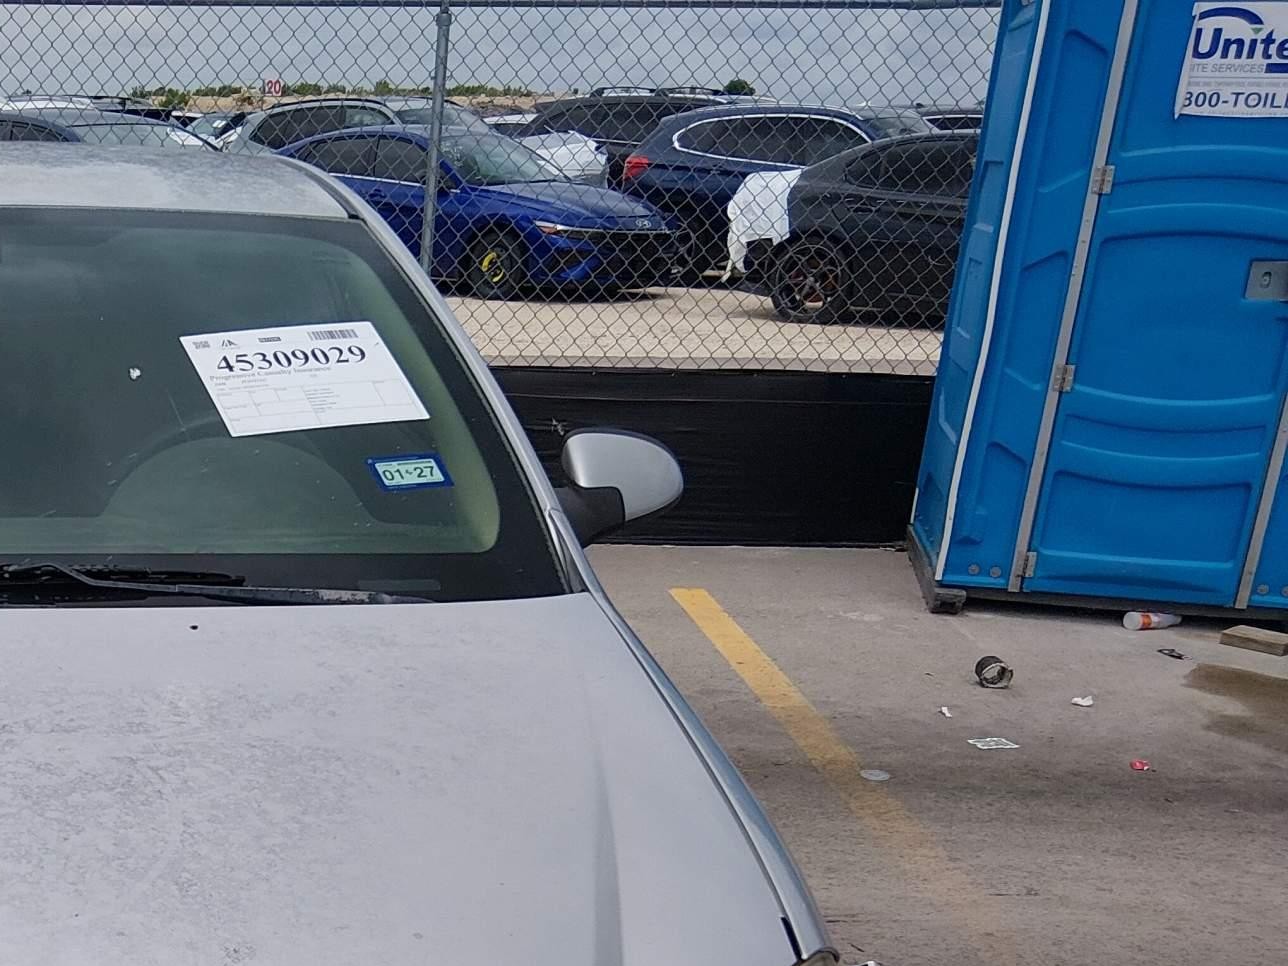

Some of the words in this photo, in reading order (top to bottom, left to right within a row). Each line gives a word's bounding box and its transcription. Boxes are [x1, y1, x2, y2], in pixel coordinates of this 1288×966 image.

[1190, 63, 1209, 73] ITE
[1210, 63, 1264, 73] SERVICES
[267, 80, 281, 94] 20
[217, 345, 366, 373] 45309029
